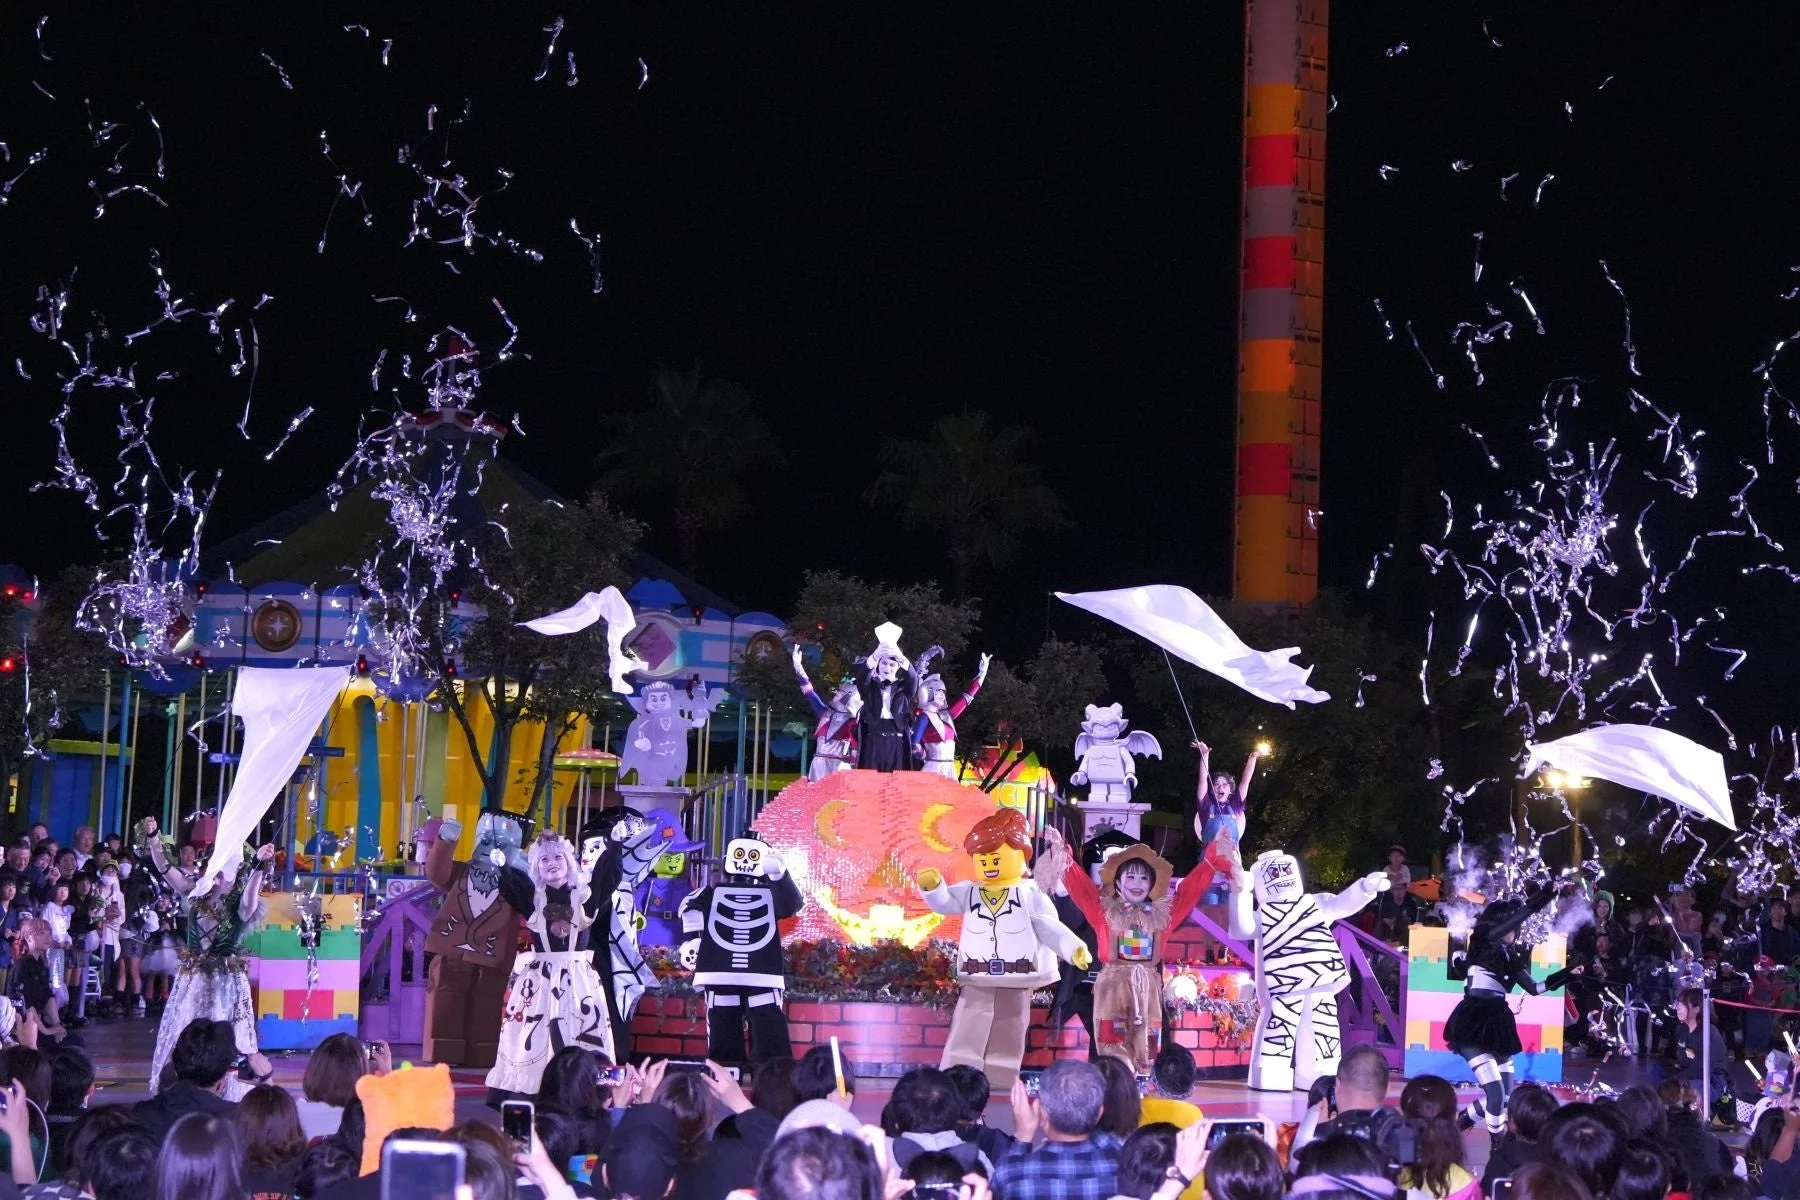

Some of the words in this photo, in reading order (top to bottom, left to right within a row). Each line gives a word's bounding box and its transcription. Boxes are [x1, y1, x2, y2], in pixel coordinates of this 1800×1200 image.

[521, 978, 535, 998] 8
[524, 1014, 545, 1051] 7
[576, 995, 605, 1048] 2
